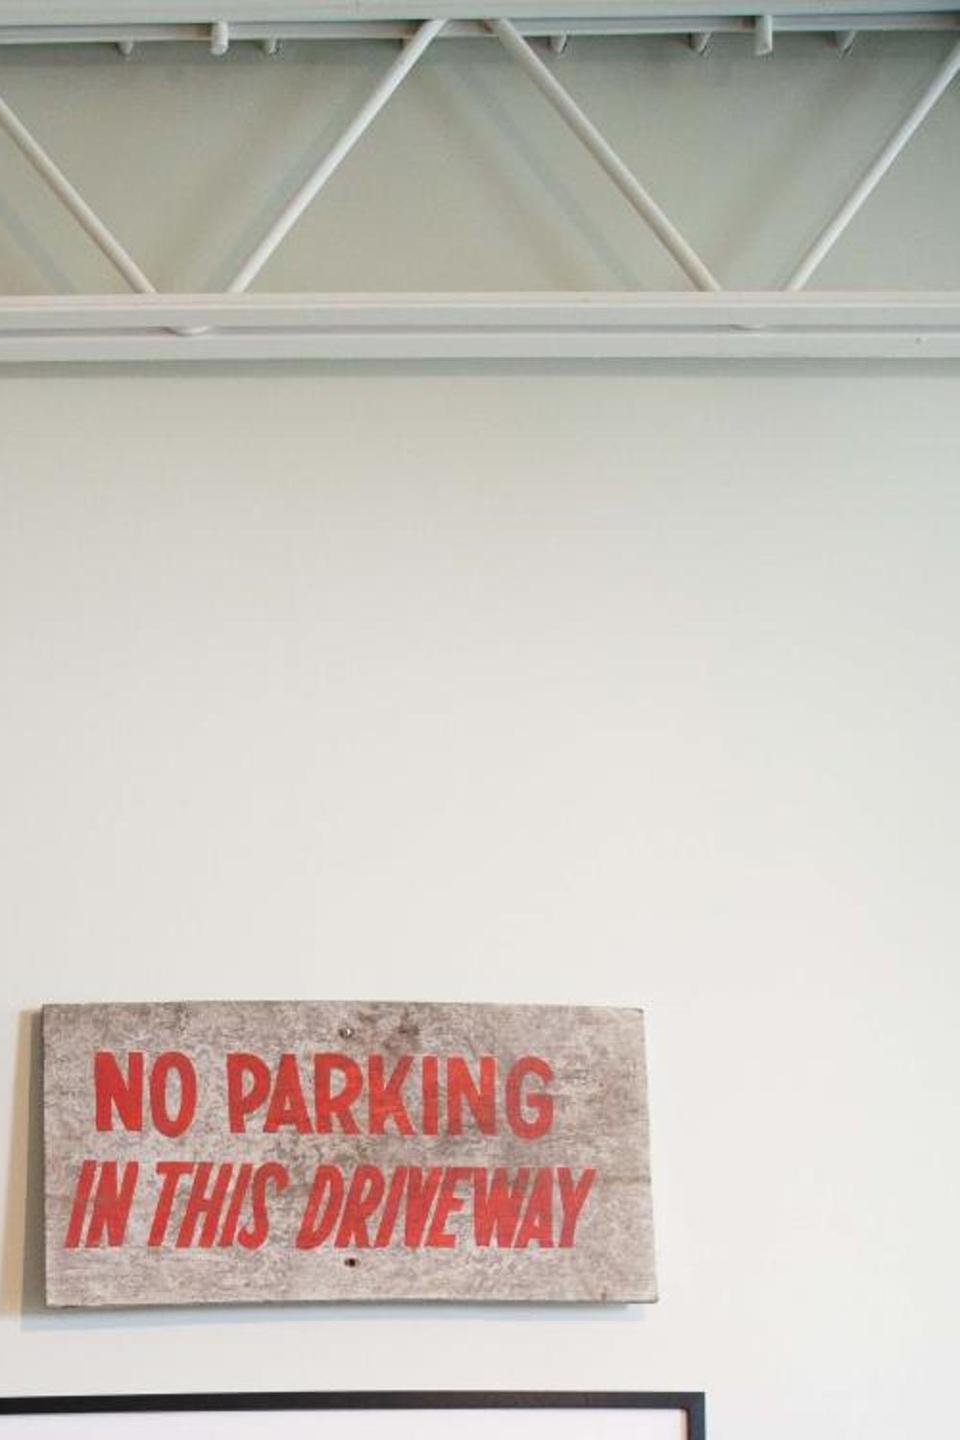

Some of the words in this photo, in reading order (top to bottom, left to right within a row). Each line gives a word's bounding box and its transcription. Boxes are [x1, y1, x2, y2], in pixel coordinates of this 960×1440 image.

[93, 1050, 198, 1138] NO
[226, 1052, 556, 1143] PARKING
[63, 1159, 140, 1250] IN
[146, 1161, 290, 1250] THIS
[293, 1165, 597, 1251] DRIVEWAY
